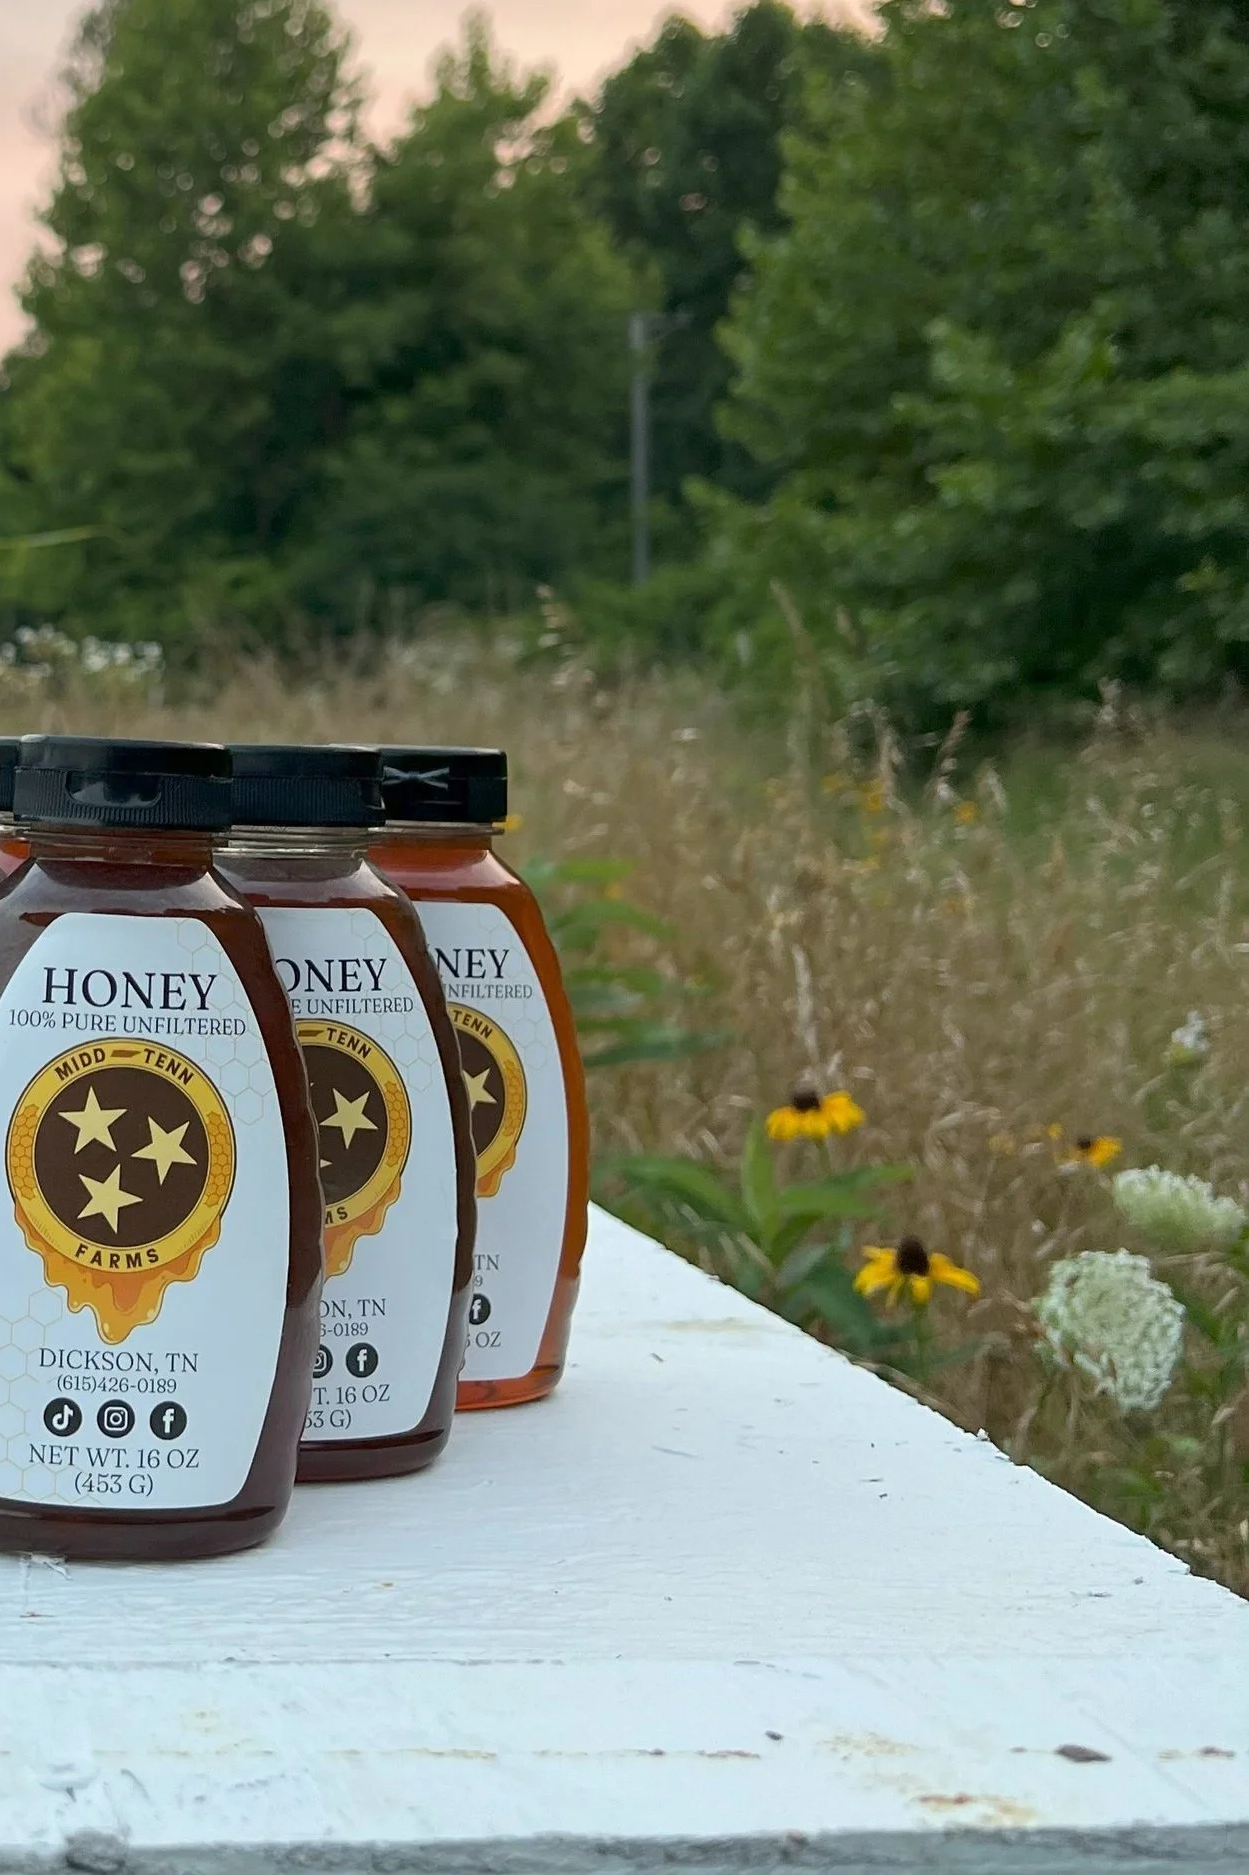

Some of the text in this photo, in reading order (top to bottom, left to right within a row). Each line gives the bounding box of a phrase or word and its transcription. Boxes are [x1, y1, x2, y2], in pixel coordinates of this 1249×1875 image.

[275, 958, 387, 992] ONEY
[434, 948, 510, 979] NEY
[42, 967, 218, 1011] HONEY
[444, 984, 533, 999] NFILTERED
[307, 997, 414, 1015] UNFILTERED
[9, 1008, 247, 1036] 100% PURE UNFILTERED
[453, 1010, 493, 1040] TENN
[326, 1027, 371, 1059] TENN
[54, 1048, 195, 1086] MIDD TENN
[74, 1242, 159, 1269] FARMS
[474, 1254, 500, 1271] TN
[357, 1298, 386, 1317] TN
[475, 1331, 501, 1348] OZ
[39, 1347, 199, 1374] DICKSON, TN
[56, 1375, 177, 1394] (615)426-0189
[313, 1384, 391, 1405] T. 16 OZ
[329, 1409, 352, 1429] G)
[29, 1443, 200, 1469] NET WT. 16 OZ
[75, 1471, 154, 1497] (453 G)
